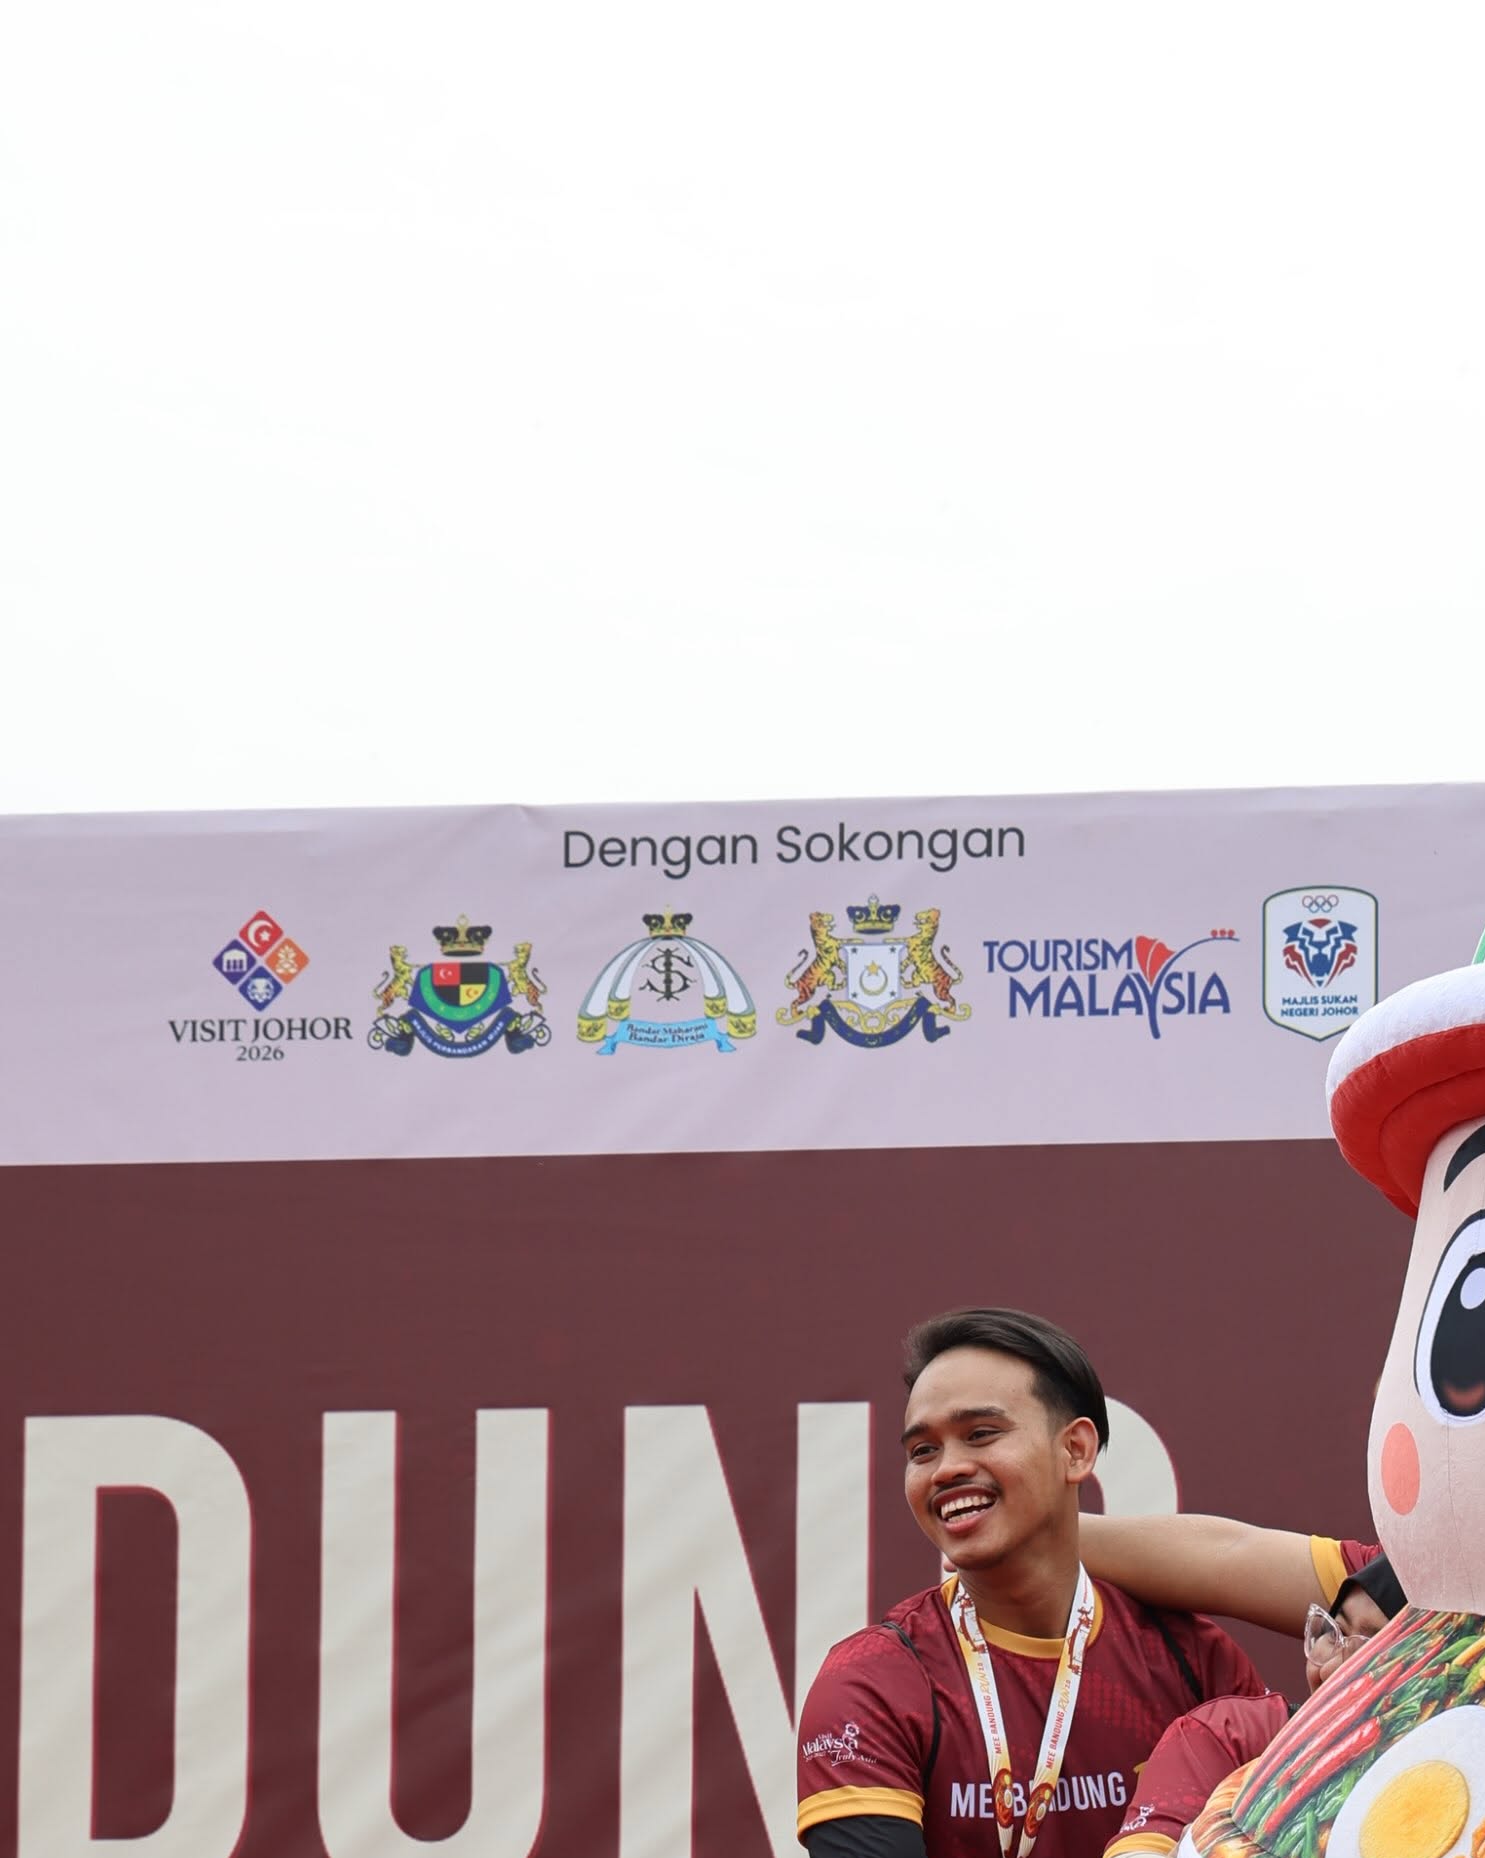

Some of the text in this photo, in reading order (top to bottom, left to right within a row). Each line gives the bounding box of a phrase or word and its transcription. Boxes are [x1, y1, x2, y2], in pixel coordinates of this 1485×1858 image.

[563, 823, 1026, 880] Dengan Sokongan
[983, 938, 1133, 973] TOURISM
[1009, 972, 1231, 1039] MALAYSIA
[1280, 1006, 1359, 1017] NEGERI JOHOR
[1281, 994, 1358, 1006] MAJLIS SUKAN
[169, 1016, 353, 1043] VISIT JOHOR
[236, 1046, 285, 1062] 2026
[978, 1672, 993, 1695] RUN
[983, 1695, 1001, 1737] BANDUNG
[1049, 1711, 1066, 1750] BANDUNG
[994, 1737, 1002, 1755] MEE
[1045, 1751, 1056, 1770] MEE
[951, 1771, 1127, 1818] ME BDUNG
